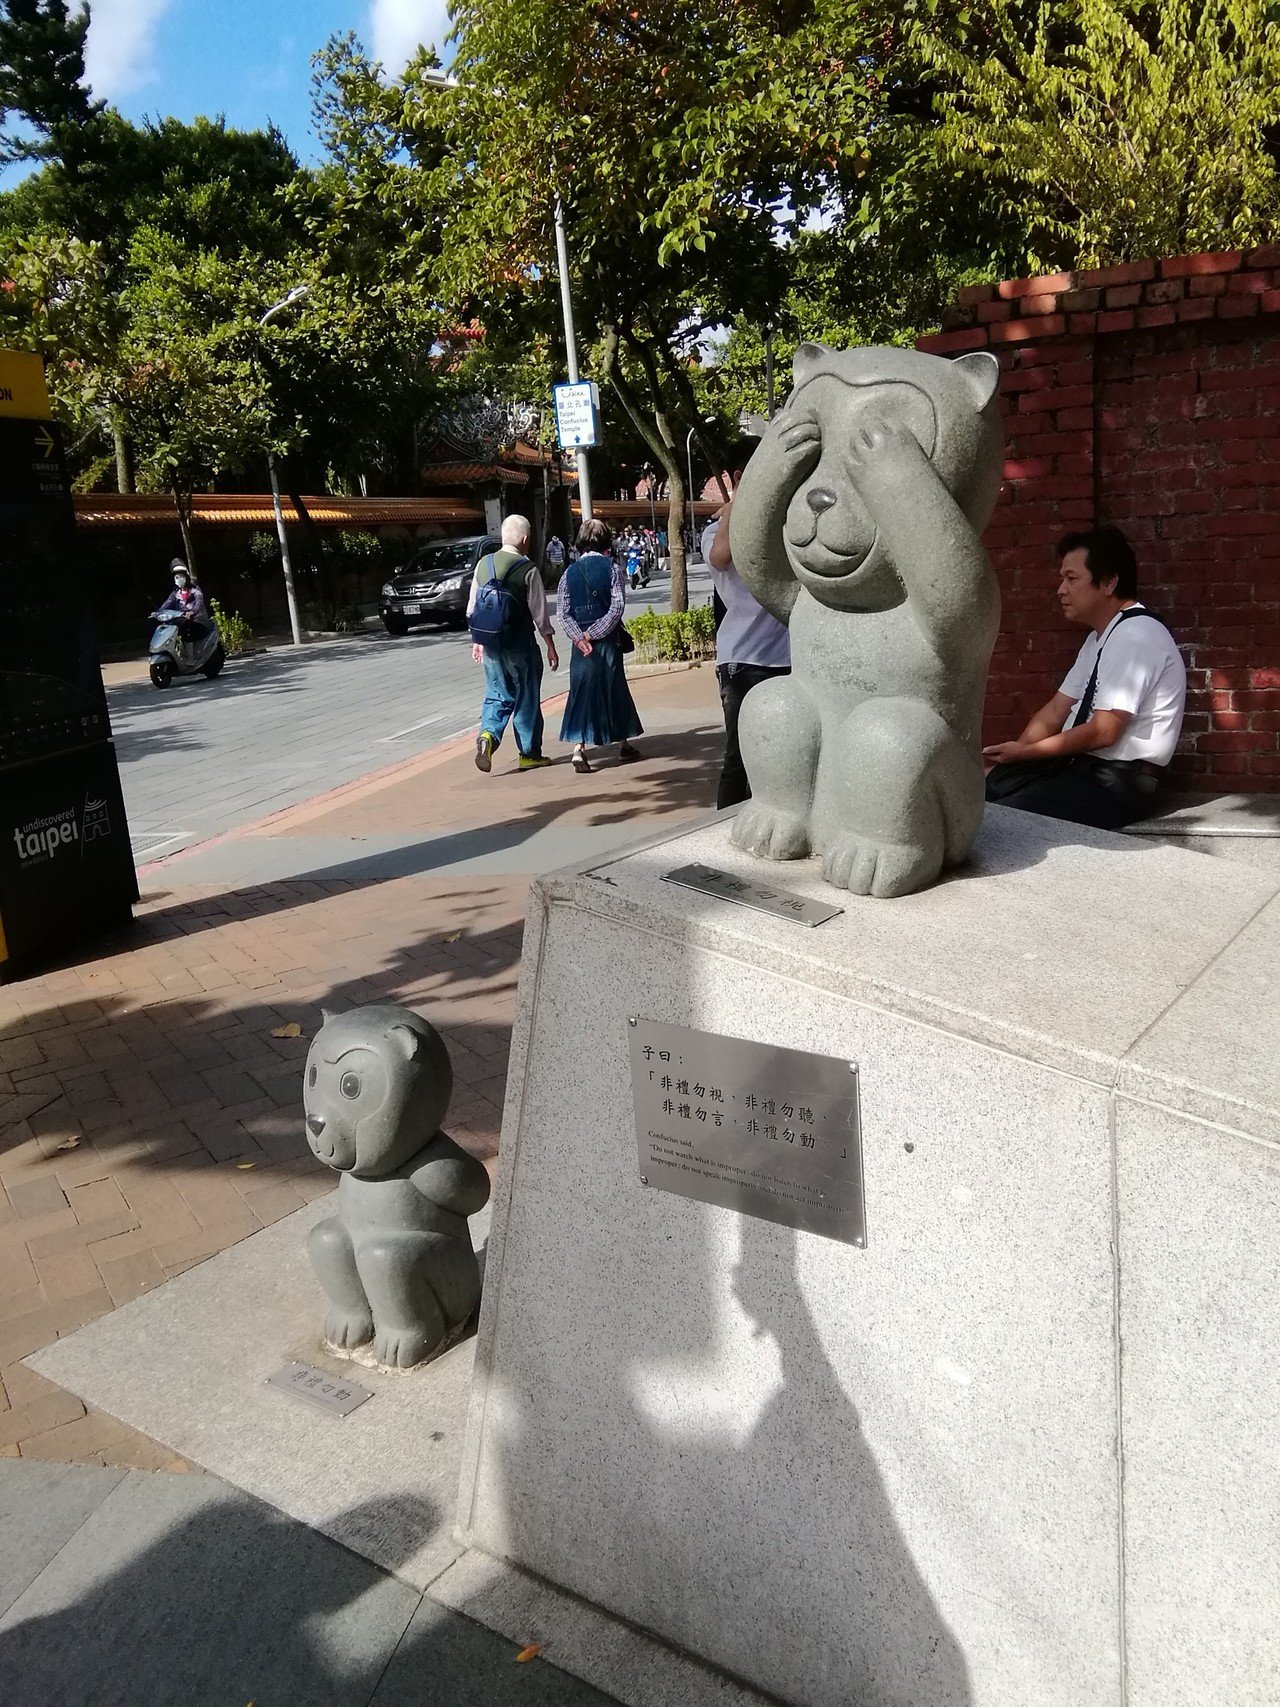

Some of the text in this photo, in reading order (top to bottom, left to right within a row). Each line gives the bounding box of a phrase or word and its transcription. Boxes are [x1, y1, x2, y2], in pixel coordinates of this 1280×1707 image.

[559, 410, 576, 418] Taipei
[22, 806, 75, 833] undiscovered
[648, 1130, 679, 1144] Confucius
[675, 1151, 693, 1160] watch
[694, 1156, 710, 1165] what
[691, 1167, 701, 1175] not
[703, 1171, 721, 1180] speak
